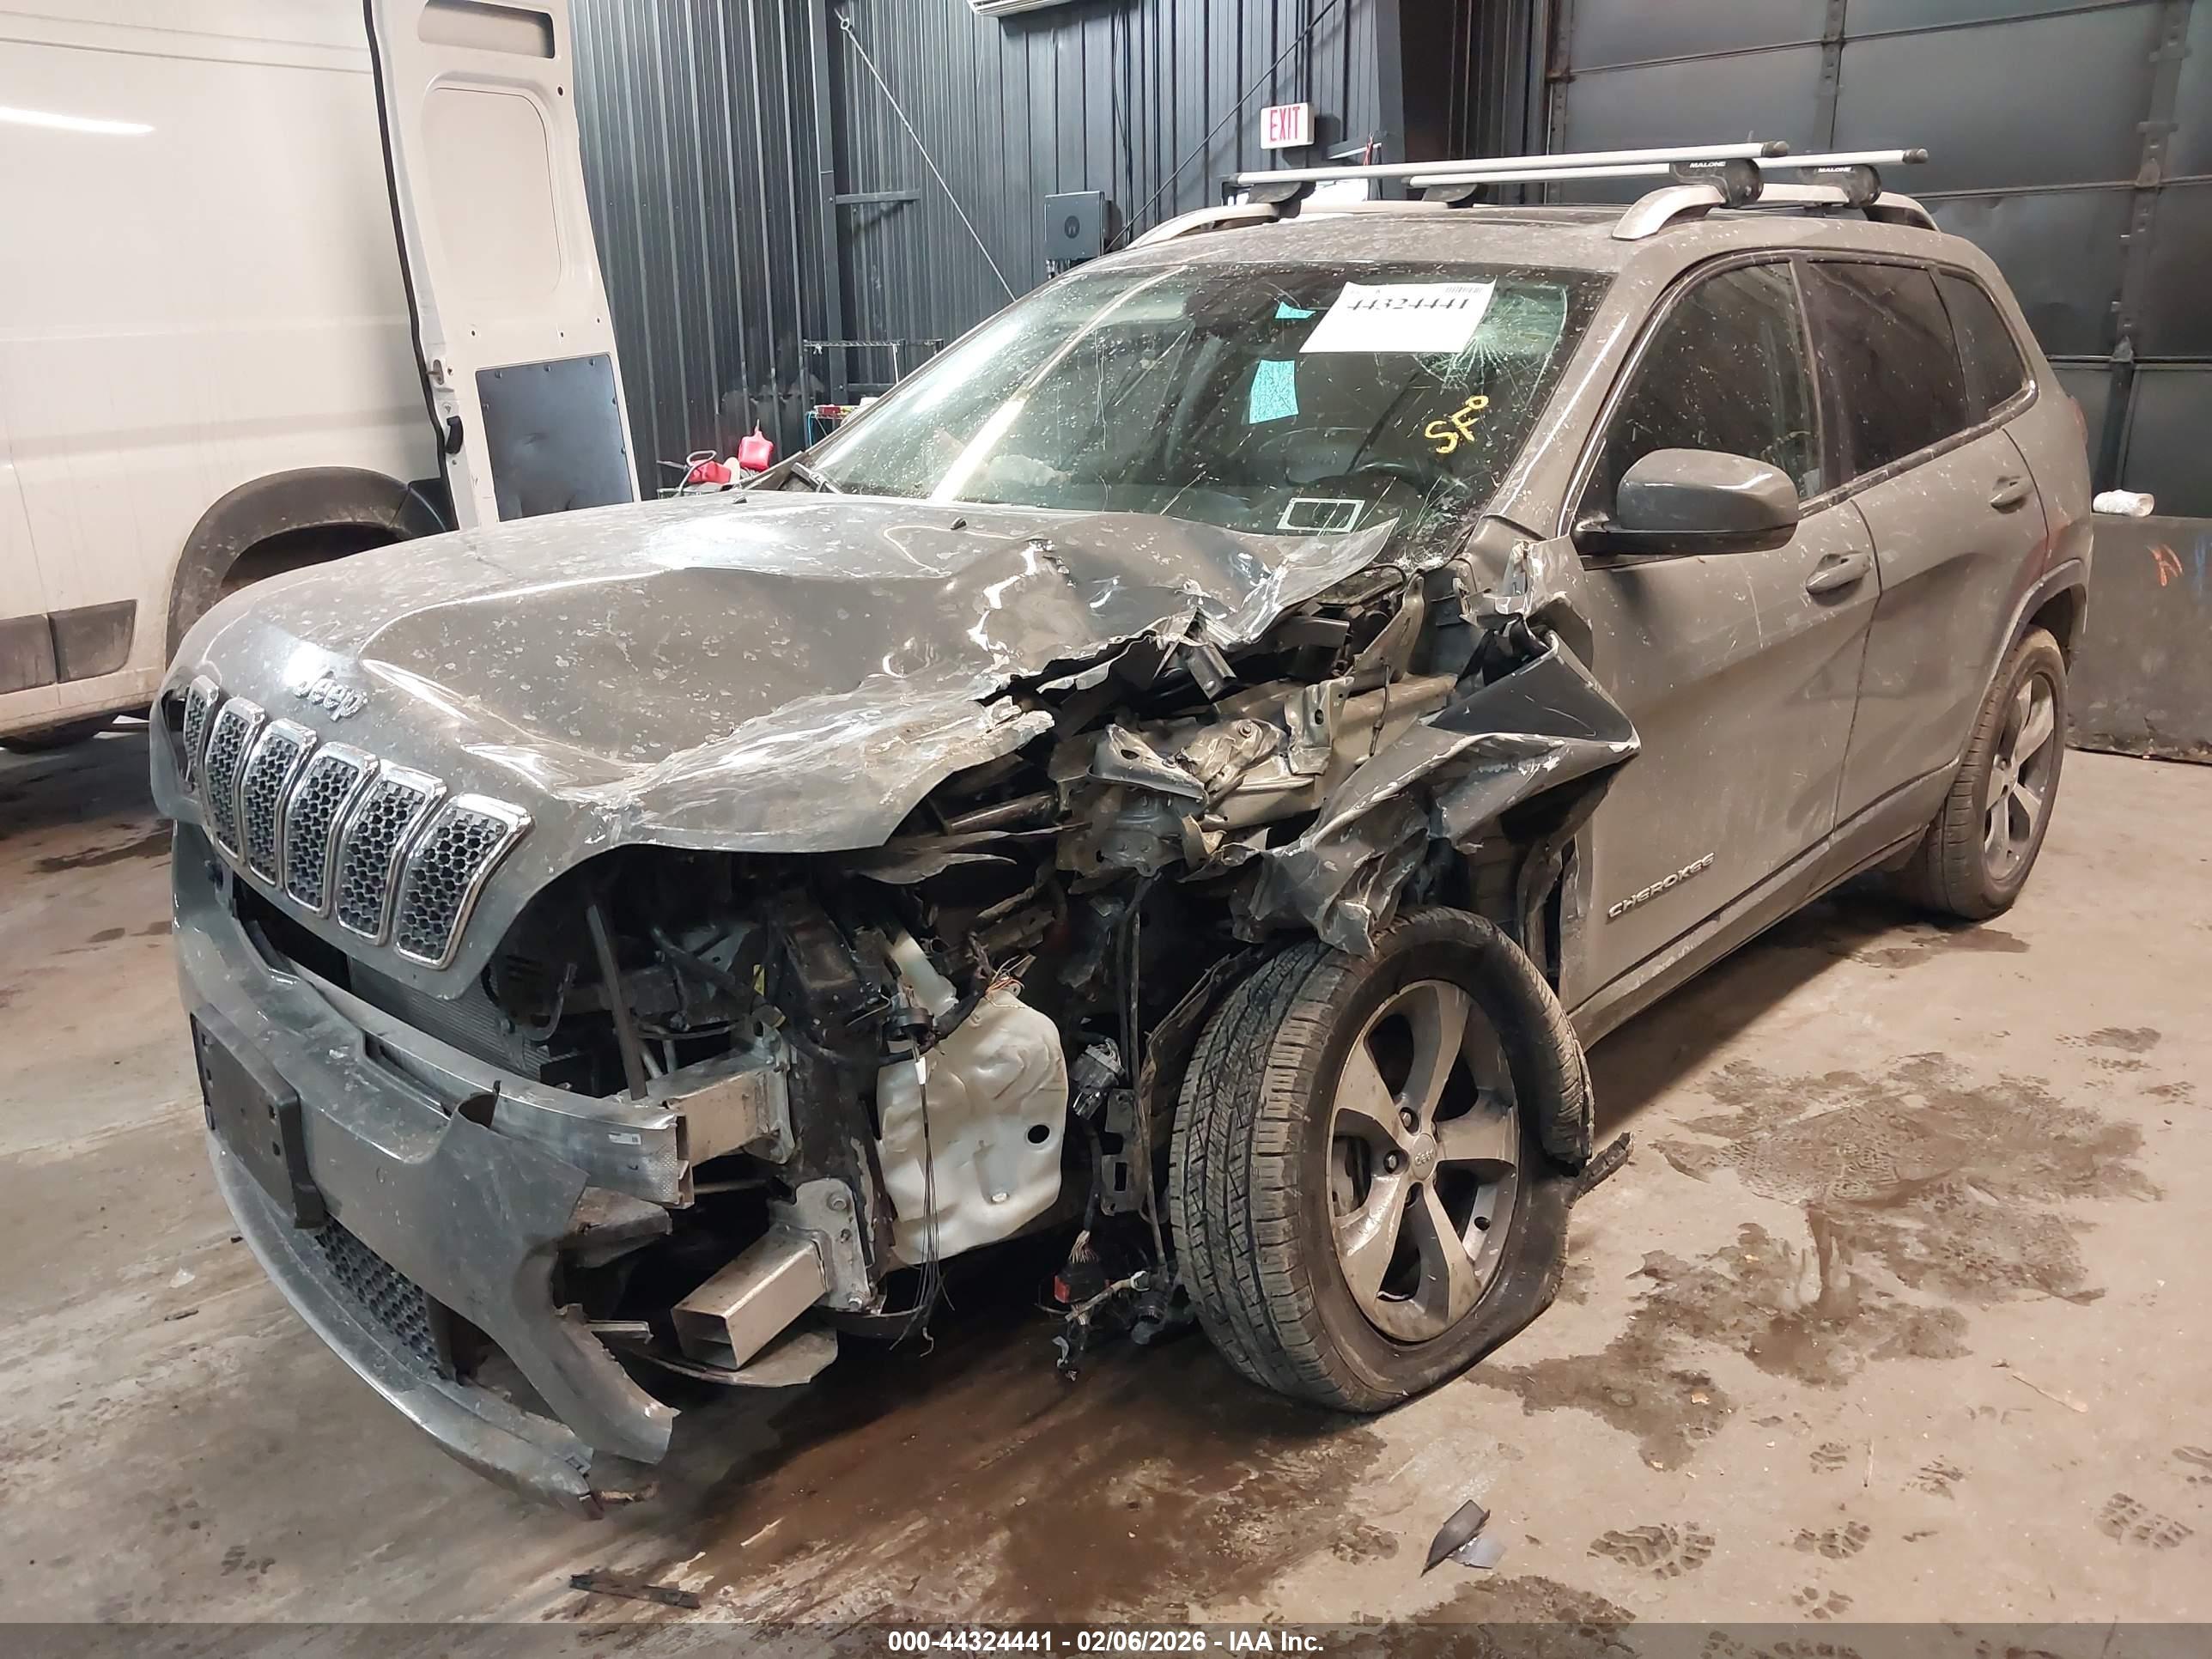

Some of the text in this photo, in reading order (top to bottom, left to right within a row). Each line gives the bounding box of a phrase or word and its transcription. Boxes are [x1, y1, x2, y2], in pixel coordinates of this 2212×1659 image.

[1270, 106, 1301, 142] EXIT
[295, 670, 364, 722] Jeep
[1608, 852, 1716, 919] CHEROKEE
